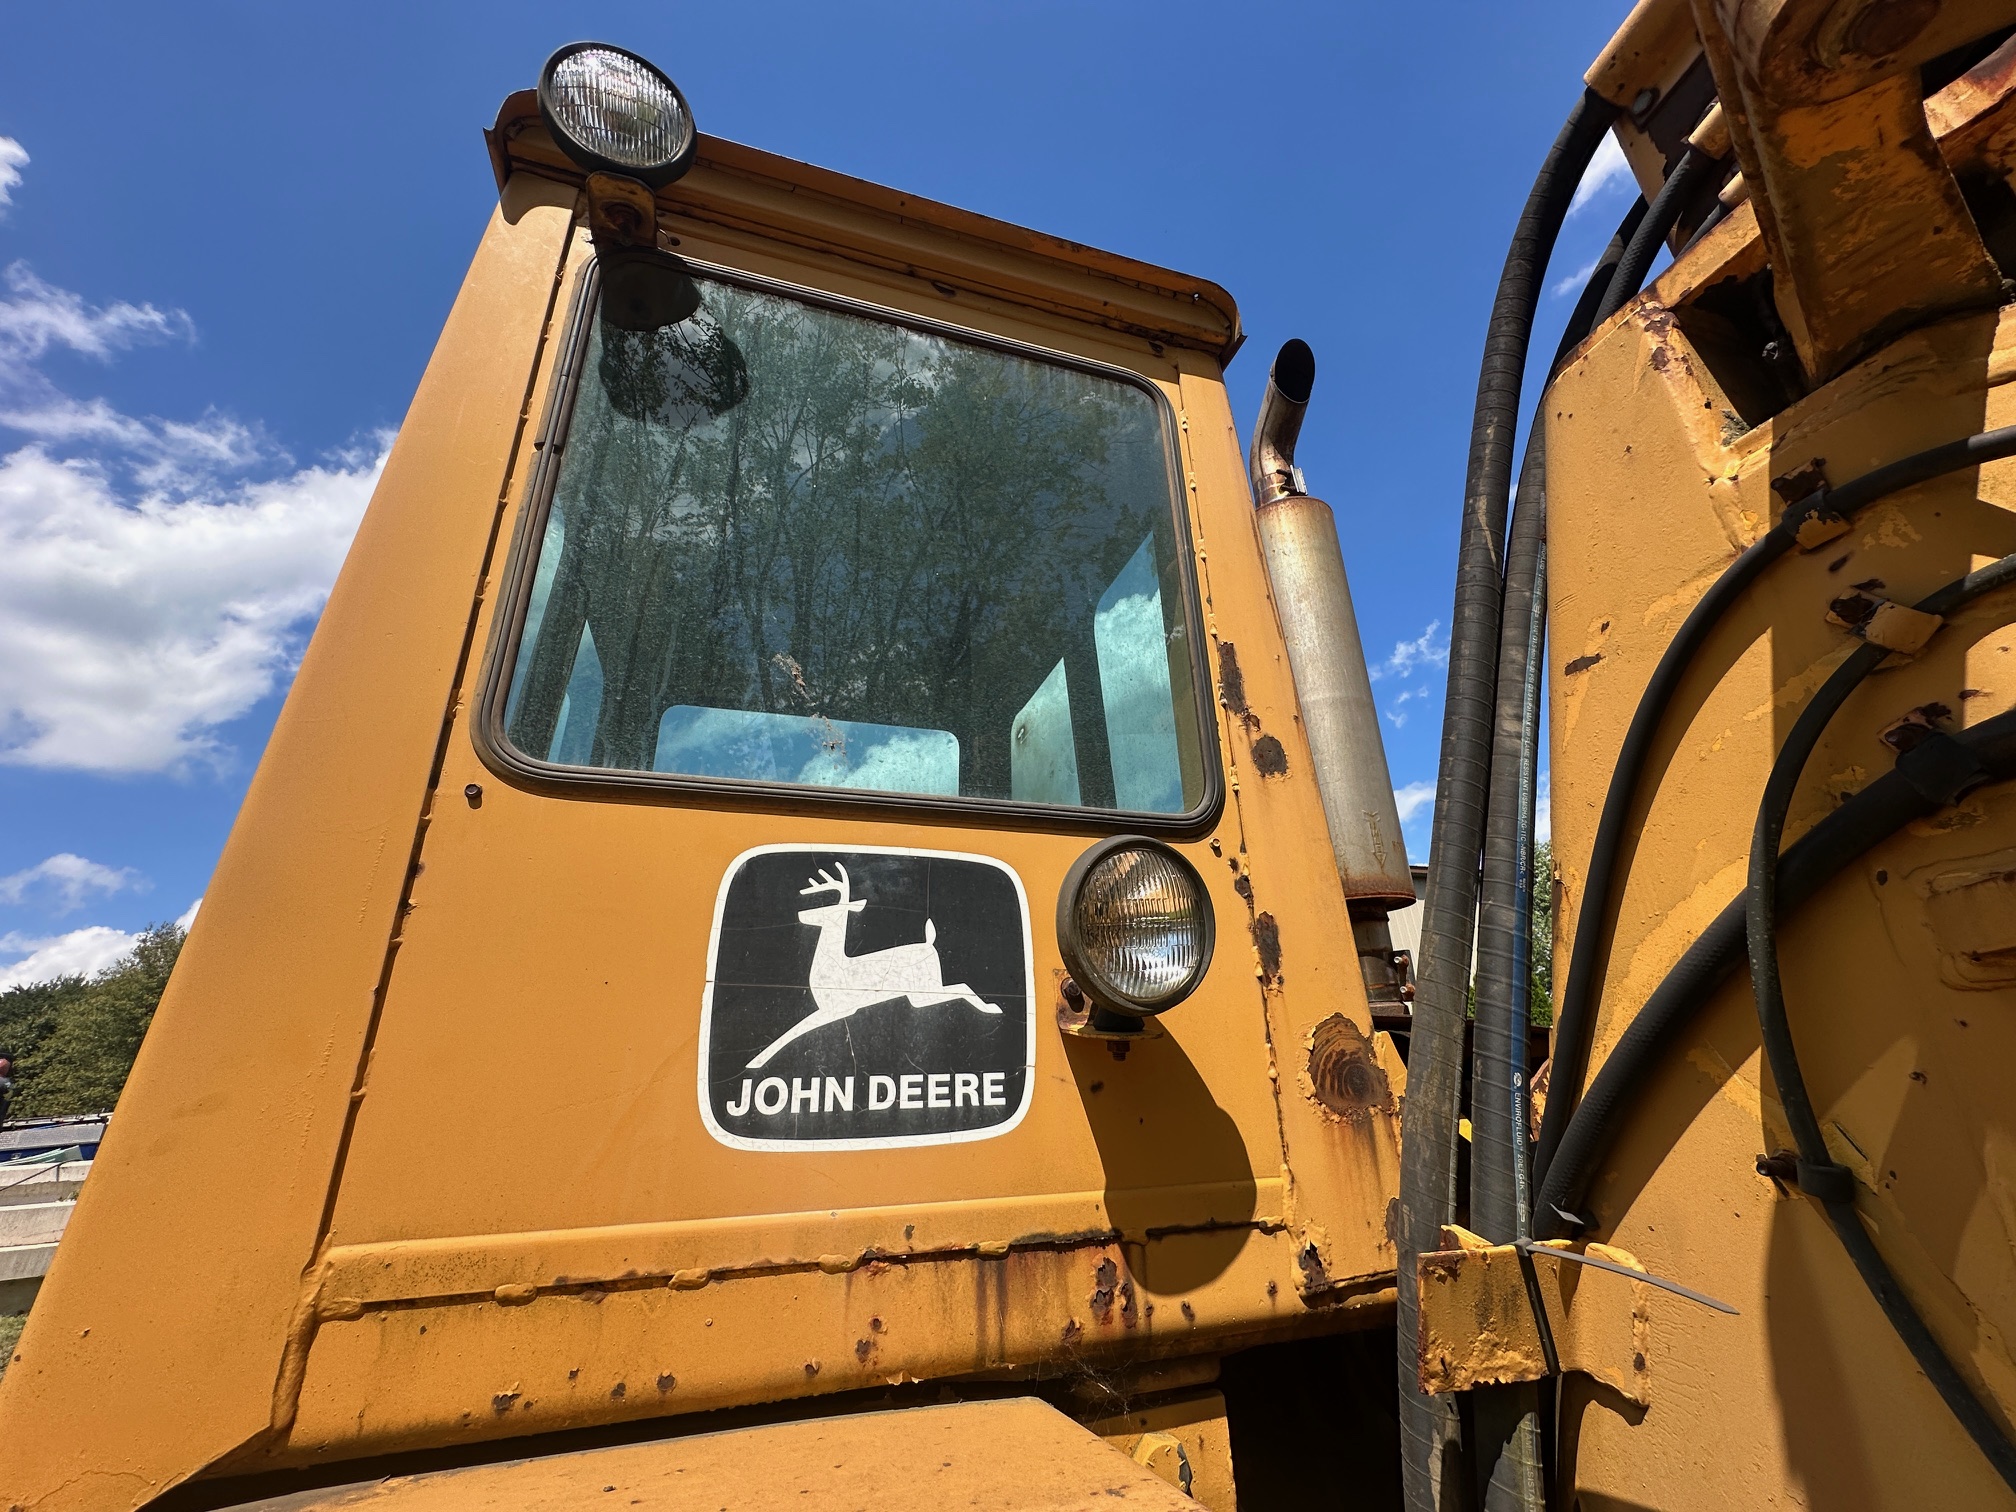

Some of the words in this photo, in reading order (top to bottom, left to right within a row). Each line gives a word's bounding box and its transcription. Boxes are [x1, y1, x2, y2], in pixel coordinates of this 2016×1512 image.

[1525, 726, 1531, 736] WP
[1522, 758, 1530, 790] RESISTANT
[726, 1076, 855, 1117] JOHN
[868, 1072, 1007, 1110] DEERE
